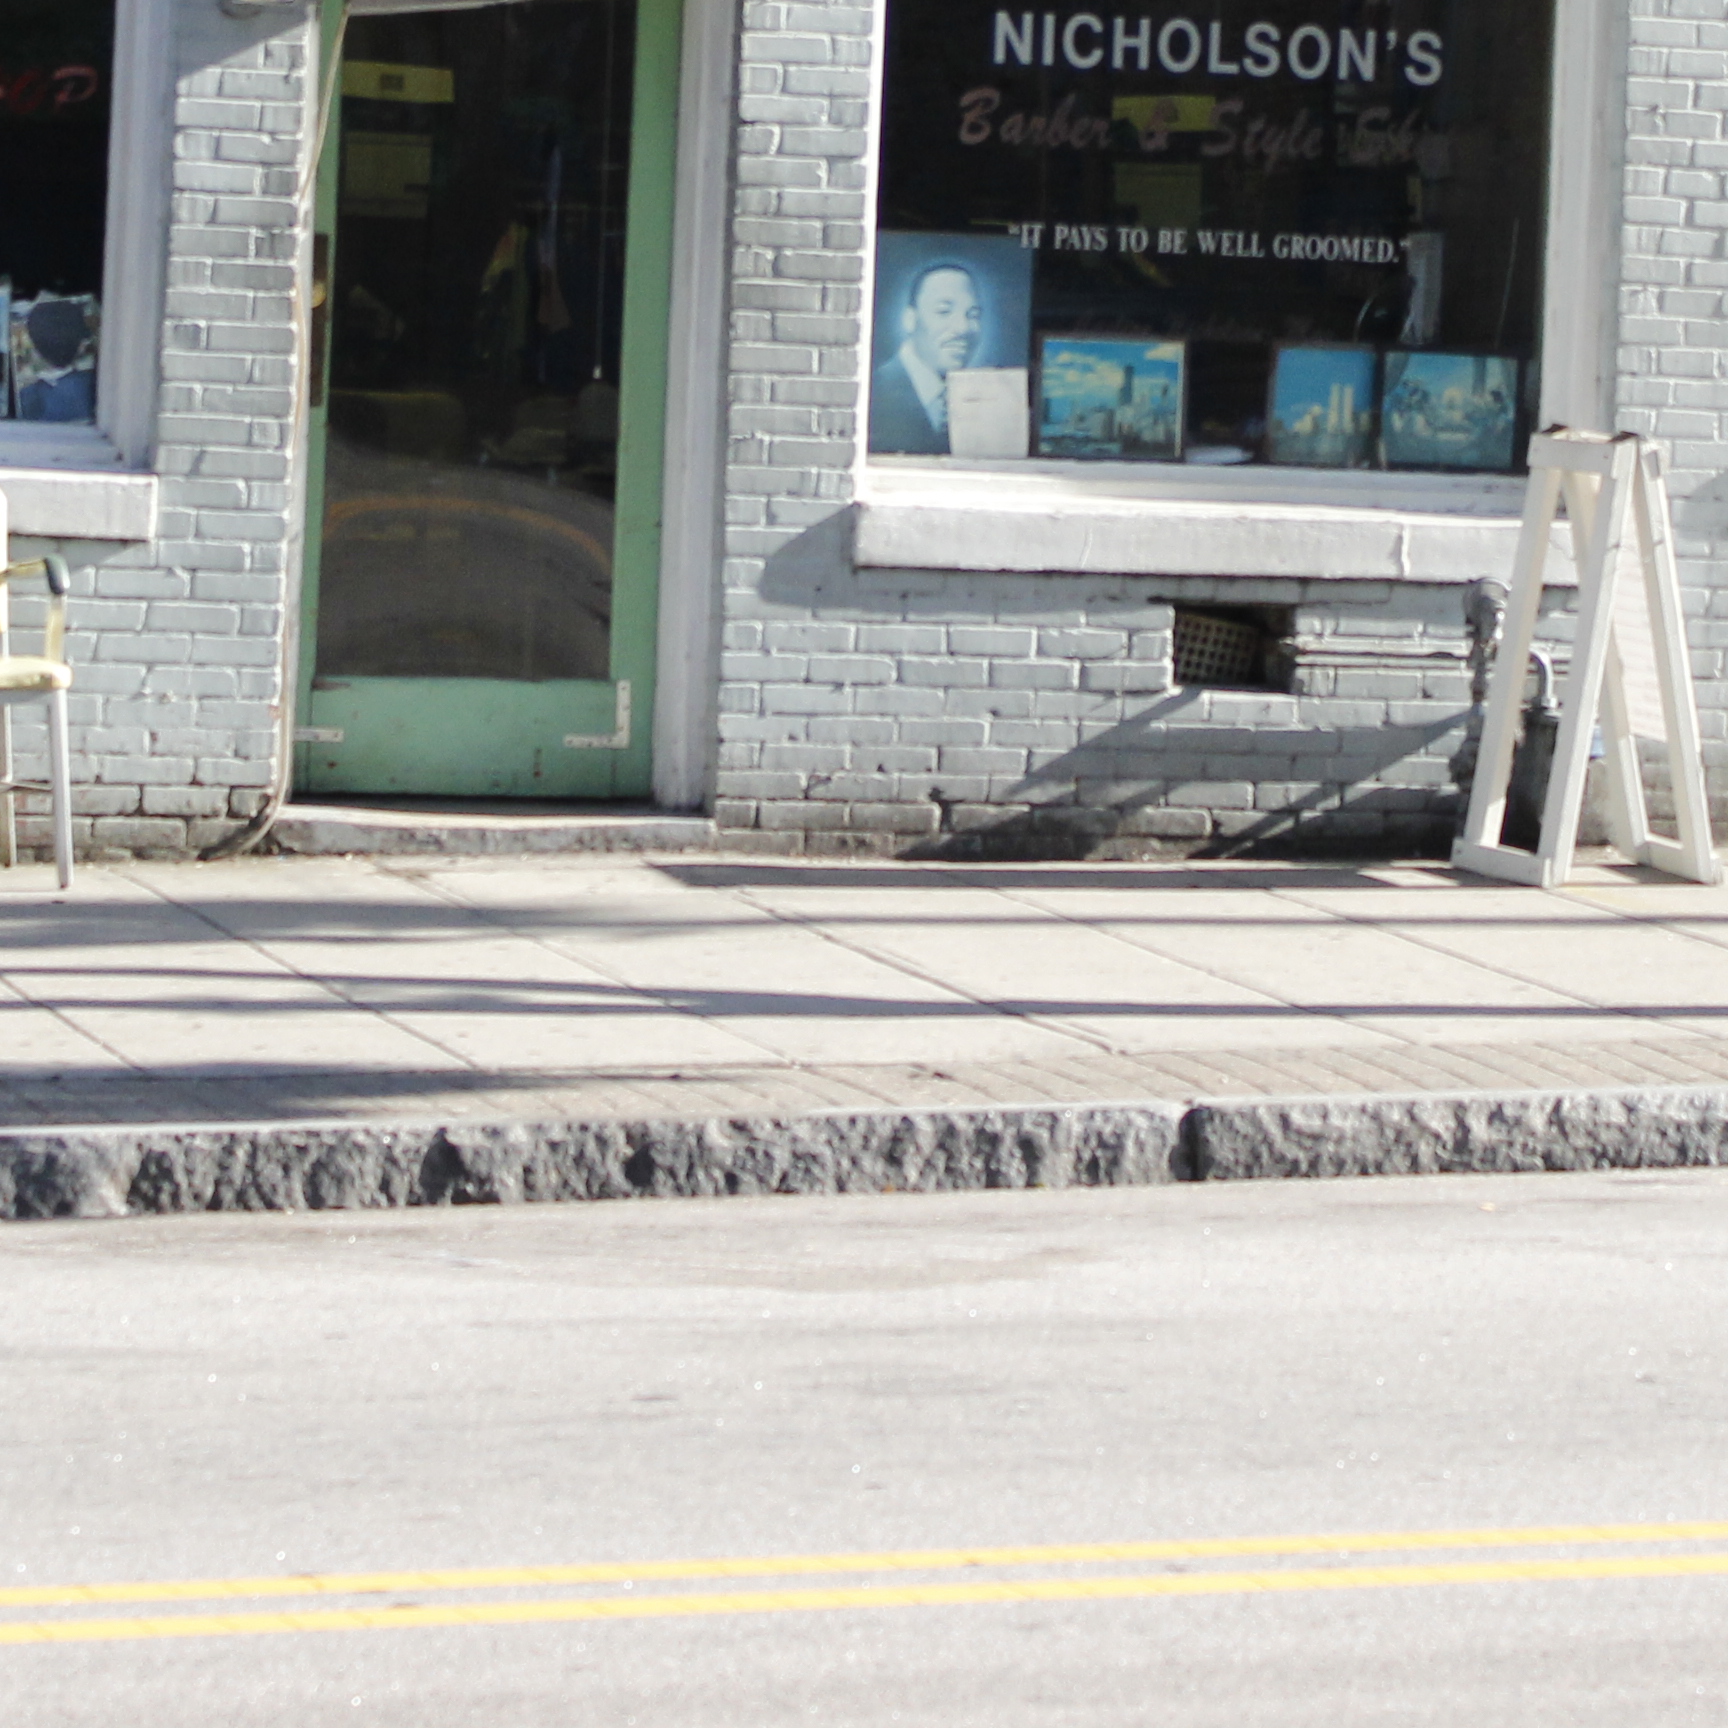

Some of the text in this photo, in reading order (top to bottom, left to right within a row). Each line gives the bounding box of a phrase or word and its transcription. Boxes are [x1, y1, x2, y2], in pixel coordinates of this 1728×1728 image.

[992, 11, 1444, 86] NICHOLSON'S
[958, 86, 1113, 149] Barber
[1201, 98, 1324, 174] Style
[1053, 224, 1108, 252] PAYS
[1117, 226, 1148, 253] TO
[1157, 228, 1188, 255] BE
[1197, 229, 1265, 259] WELL
